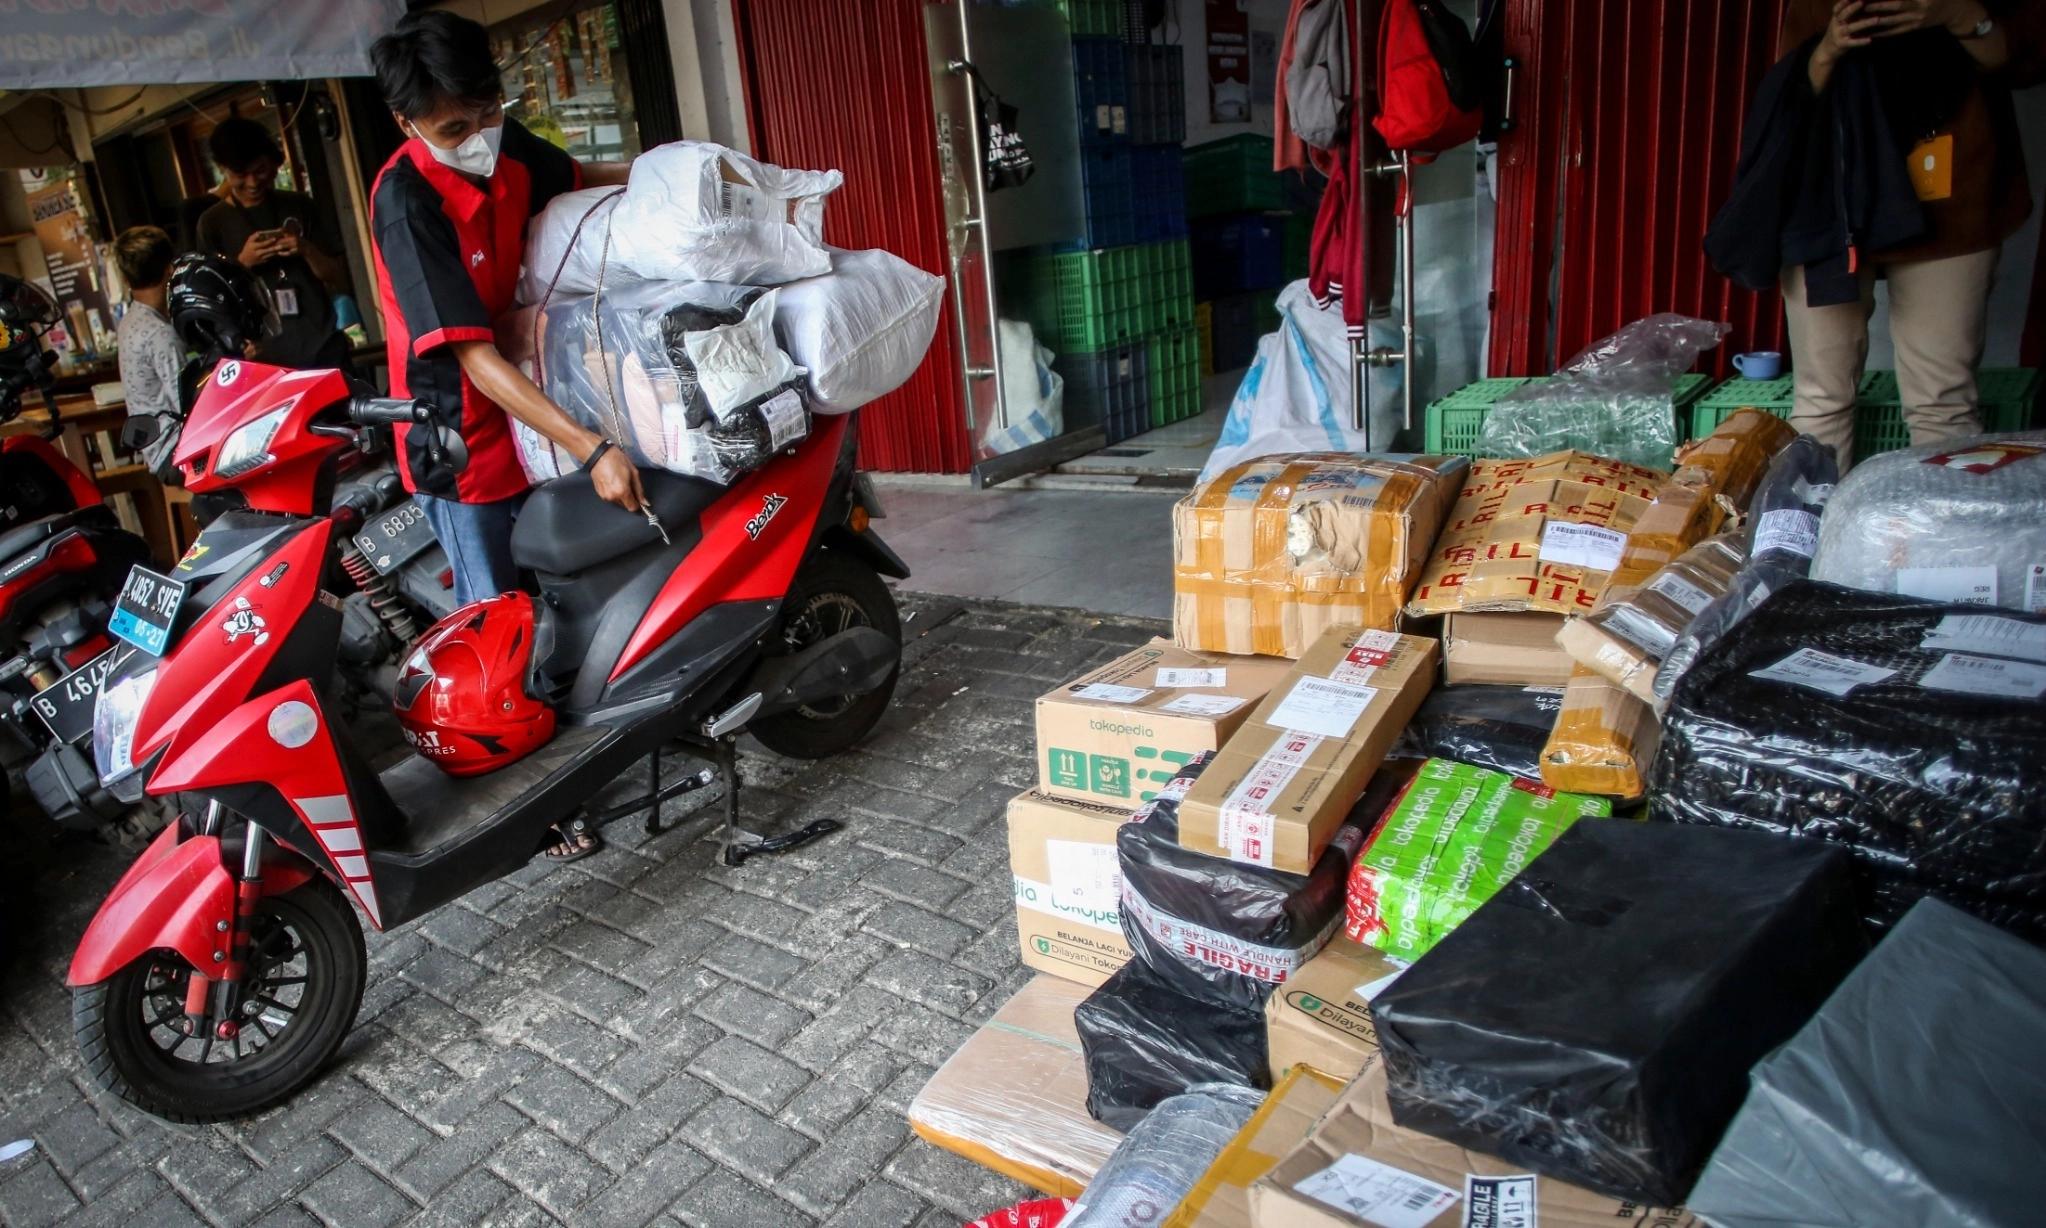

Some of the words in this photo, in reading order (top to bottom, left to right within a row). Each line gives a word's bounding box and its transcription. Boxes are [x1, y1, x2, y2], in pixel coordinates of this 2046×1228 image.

[361, 536, 376, 552] B
[382, 504, 424, 537] 6835
[4, 555, 37, 577] HONDA
[37, 697, 58, 718] B
[1090, 719, 1154, 738] tokopedia
[1390, 787, 1441, 846] tokopedia
[1056, 930, 1095, 948] BELANJA
[1096, 941, 1116, 953] LAGI
[1179, 926, 1210, 943] CARE
[1211, 937, 1240, 953] WITH
[1051, 944, 1090, 963] Dilayani
[1183, 940, 1288, 983] FRAGILE
[1243, 949, 1292, 965] HANDLE
